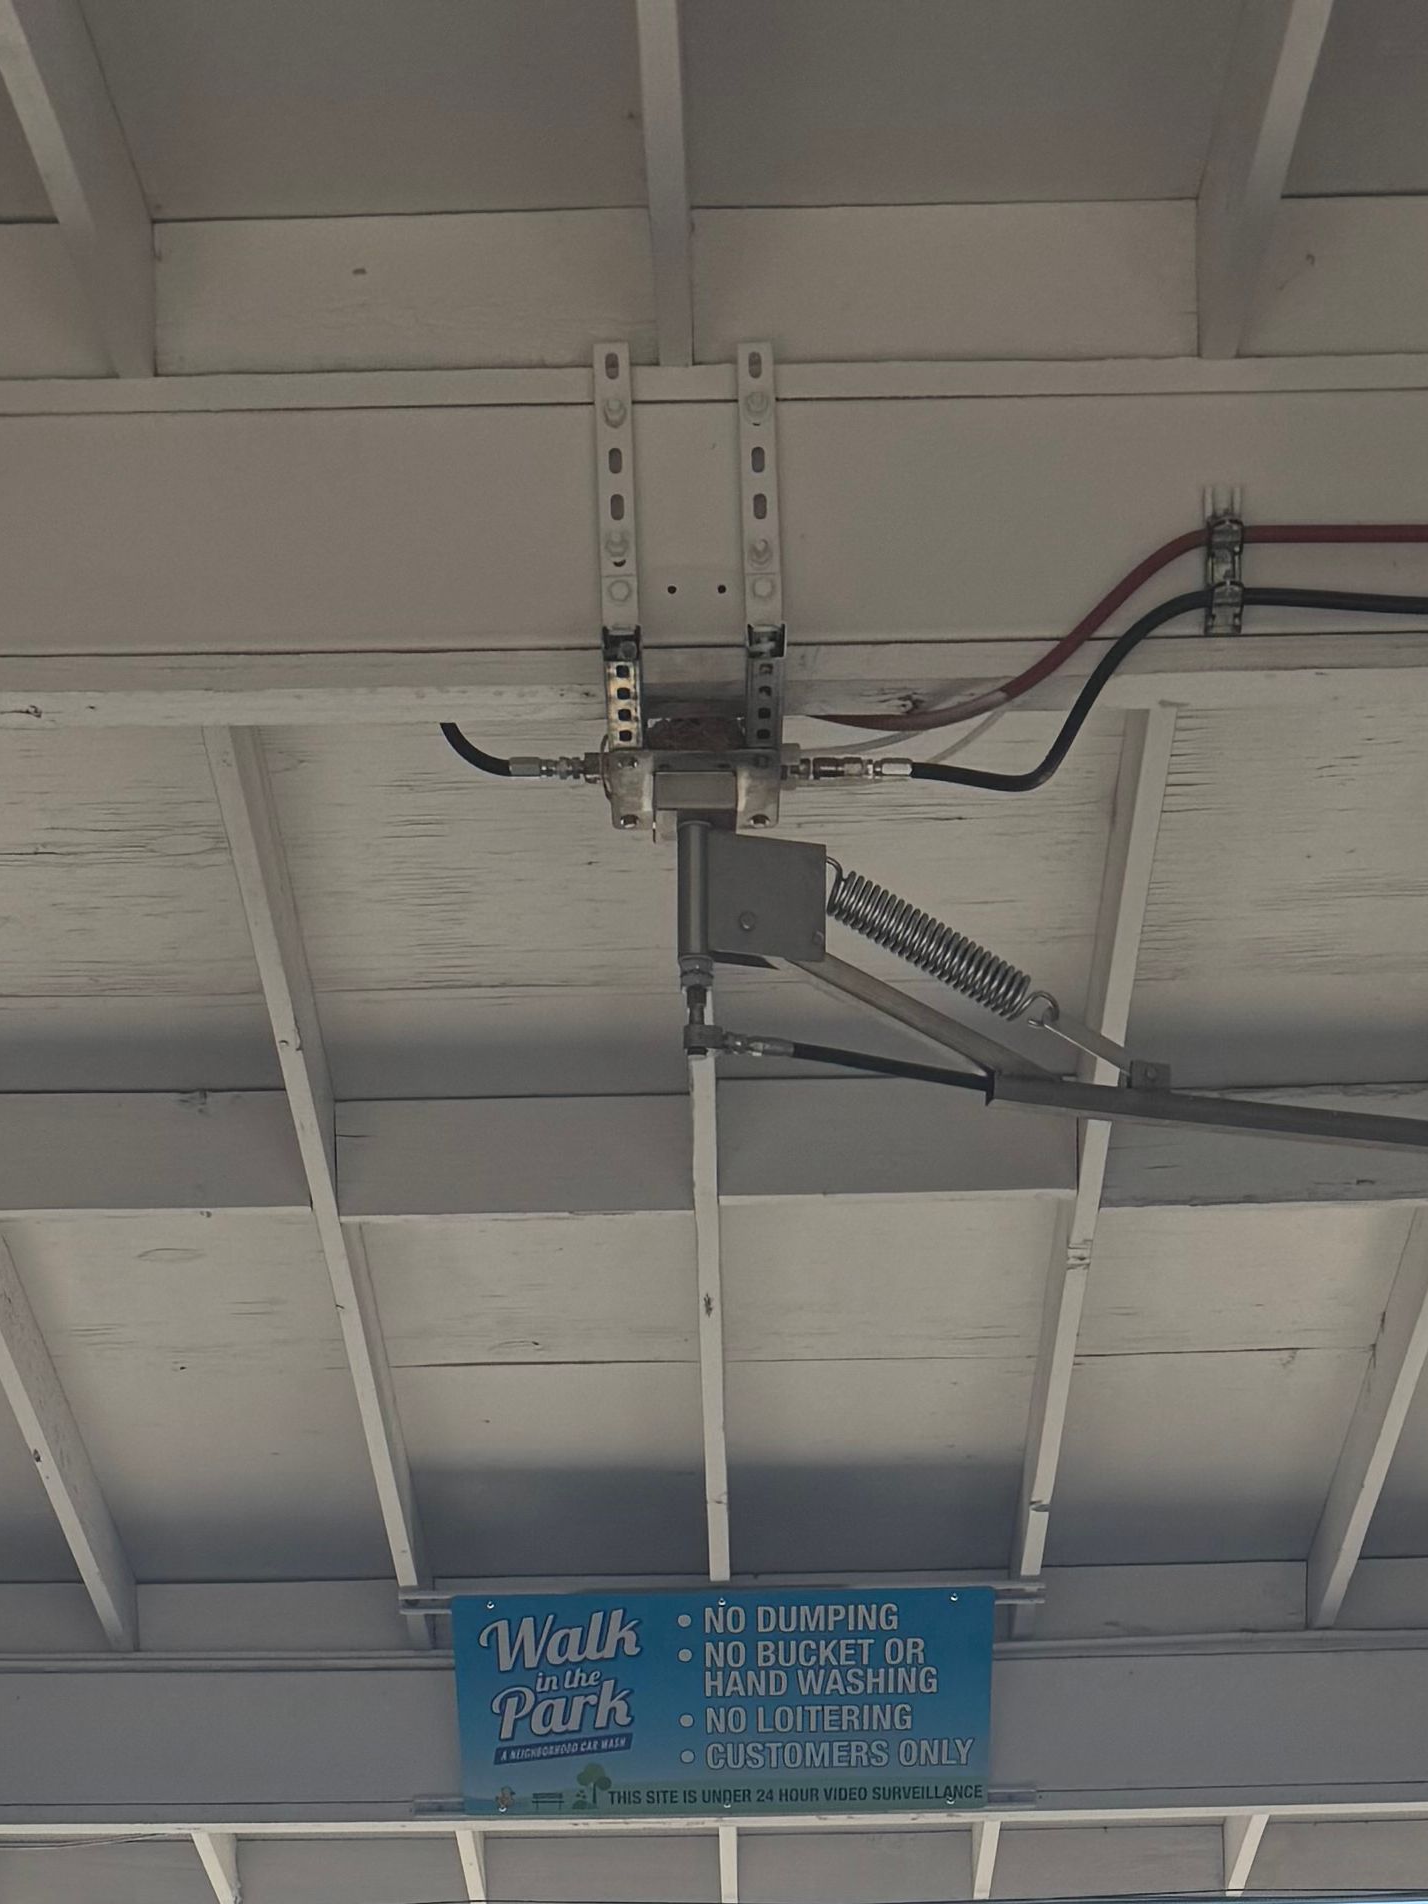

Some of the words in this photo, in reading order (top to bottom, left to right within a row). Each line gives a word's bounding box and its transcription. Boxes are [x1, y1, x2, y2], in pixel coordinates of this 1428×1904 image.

[704, 1606, 746, 1633] NO
[757, 1603, 899, 1632] DUMPING
[479, 1608, 641, 1671] Walk
[704, 1641, 746, 1667] NO
[757, 1639, 875, 1667] BUCKET
[884, 1637, 925, 1665] OR
[536, 1672, 558, 1692] in
[563, 1667, 601, 1689] the
[704, 1669, 788, 1697] HAND
[796, 1667, 939, 1695] WASHING
[492, 1680, 632, 1740] Park
[706, 1707, 746, 1733] NO
[757, 1704, 913, 1733] LOITERING
[500, 1750, 508, 1760] A
[510, 1743, 578, 1759] NEIGHBORHOOD
[581, 1741, 599, 1751] CAR
[601, 1738, 626, 1749] WASH
[706, 1740, 890, 1769] CUSTOMERS
[898, 1738, 973, 1766] ONLY
[608, 1790, 641, 1805] THIS
[646, 1790, 678, 1804] SITE
[683, 1789, 697, 1804] IS
[702, 1788, 752, 1803] UNDER
[756, 1788, 773, 1802] 24
[779, 1787, 819, 1802] HOUR
[823, 1786, 867, 1801] VIDEO
[872, 1784, 983, 1800] SURVEILLANCE
